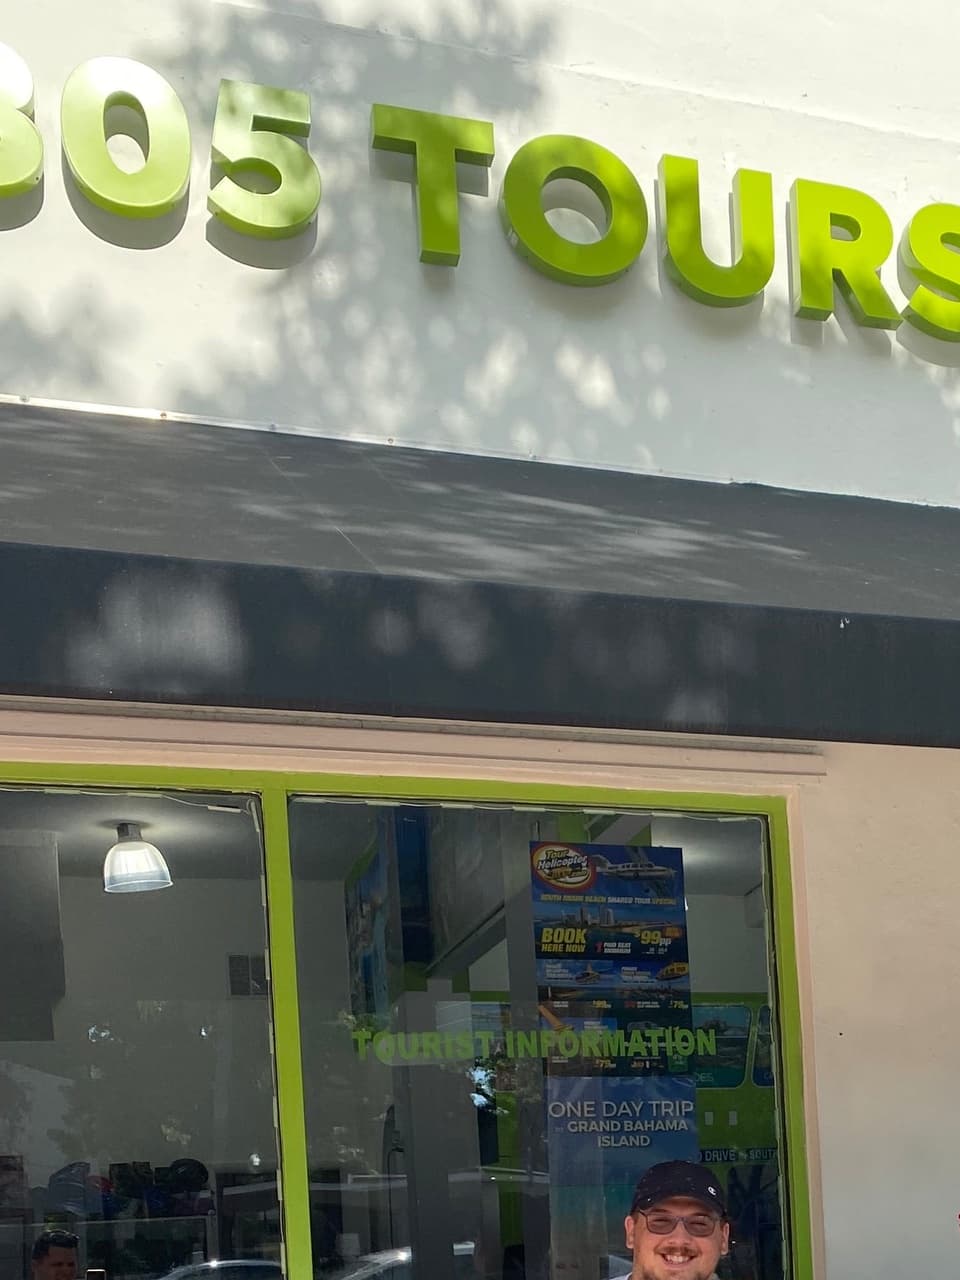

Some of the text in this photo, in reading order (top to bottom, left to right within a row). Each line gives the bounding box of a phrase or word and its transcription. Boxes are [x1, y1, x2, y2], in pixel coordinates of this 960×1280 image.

[541, 928, 587, 943] BOOK
[541, 943, 564, 953] HERE
[565, 943, 586, 953] NOW
[352, 1029, 716, 1063] TOURIST INFORMATION
[549, 1101, 694, 1118] ONE DAY TRIP
[568, 1119, 688, 1132] GRAND BAHAMA
[597, 1135, 651, 1147] ISLAND
[705, 1150, 736, 1161] DRIVE
